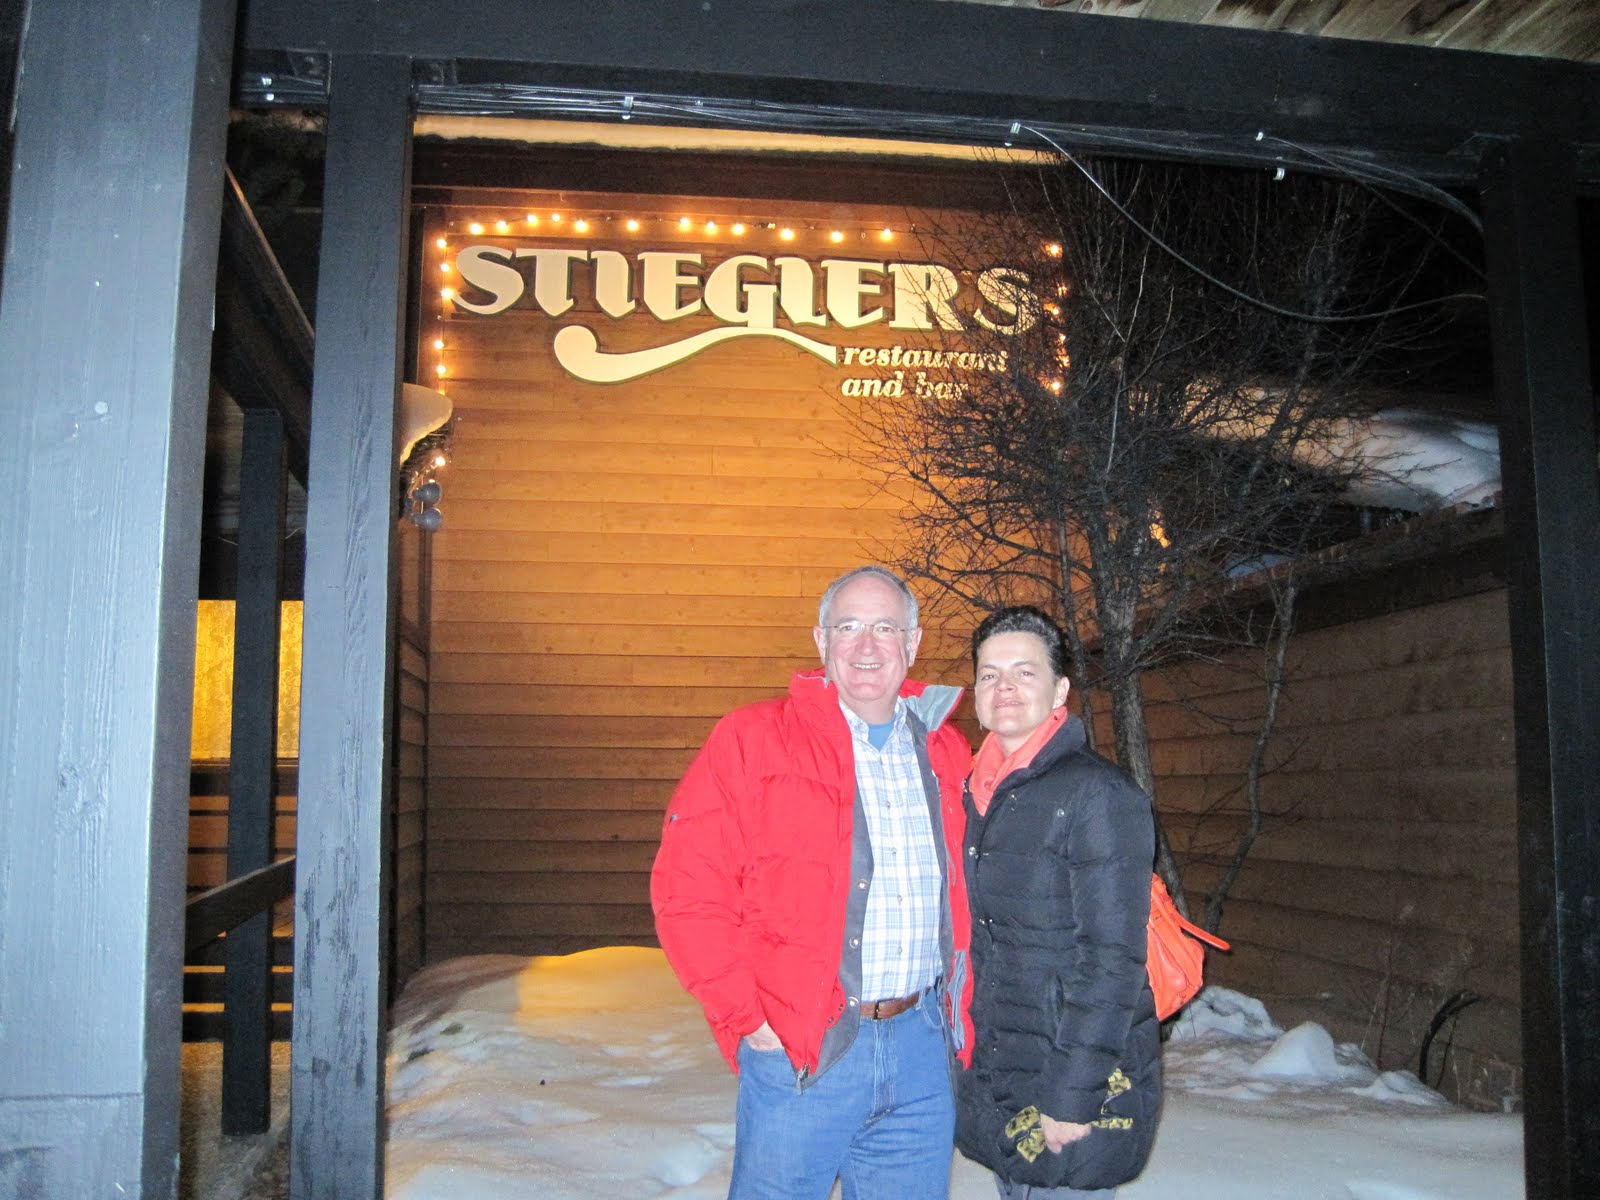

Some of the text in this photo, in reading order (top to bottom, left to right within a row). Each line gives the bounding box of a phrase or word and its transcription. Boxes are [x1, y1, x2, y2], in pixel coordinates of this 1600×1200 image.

[843, 345, 1009, 373] restaurant
[841, 370, 969, 401] and bar
